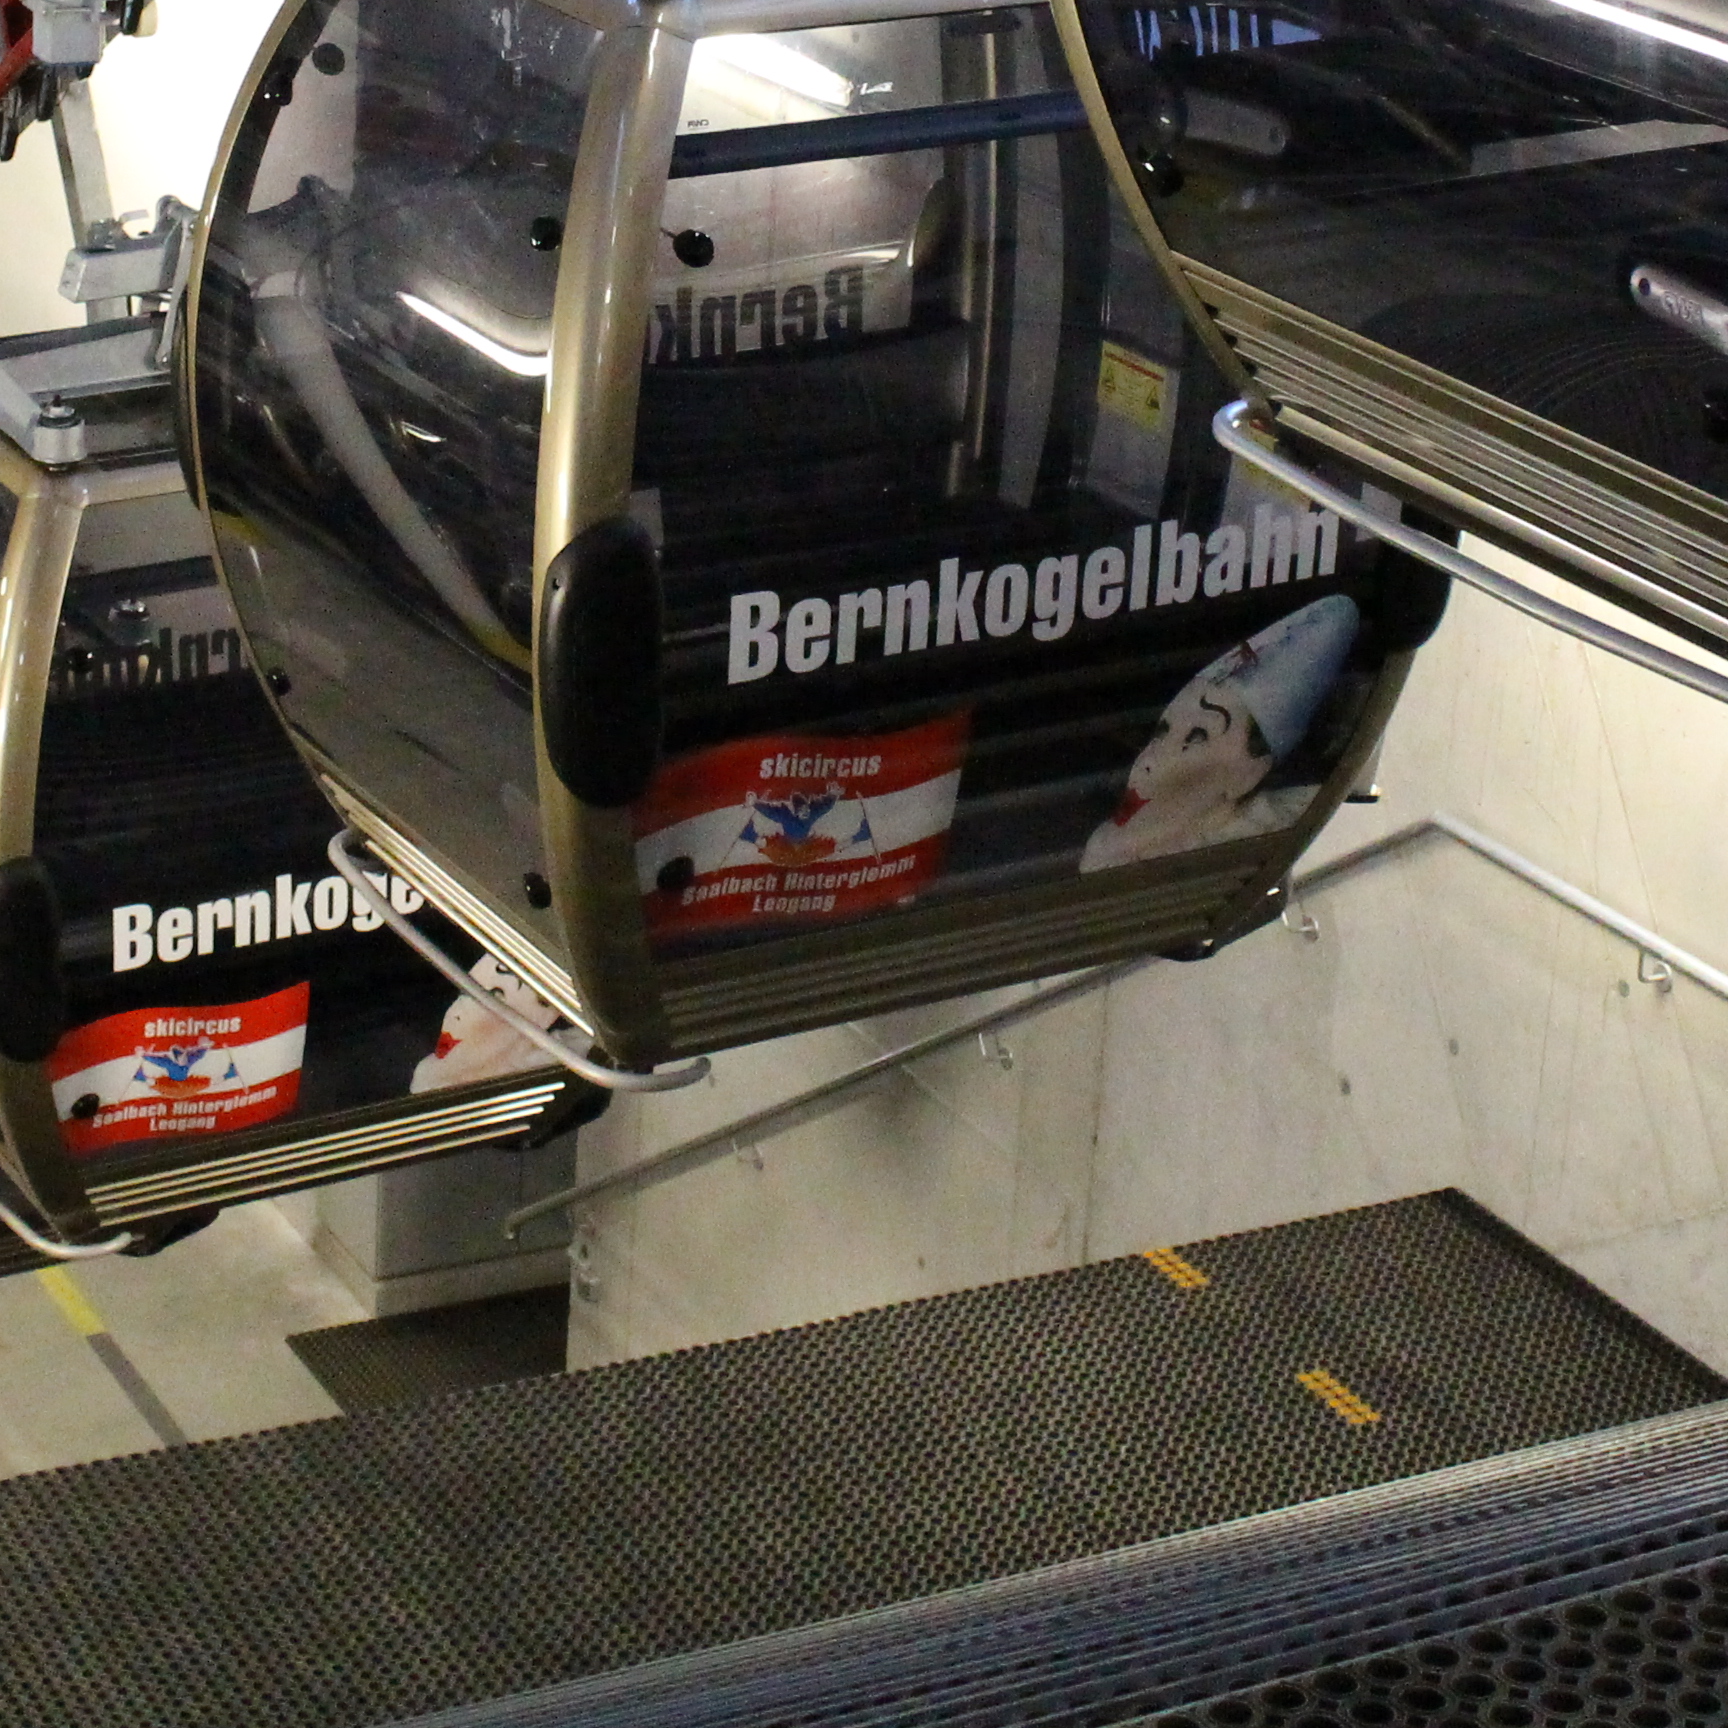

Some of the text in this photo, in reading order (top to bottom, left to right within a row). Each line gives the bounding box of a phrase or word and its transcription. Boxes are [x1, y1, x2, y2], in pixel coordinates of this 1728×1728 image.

[727, 503, 1340, 685] Bernkogelbahn
[759, 753, 882, 779] skicircus
[681, 872, 778, 907] Saalbach
[752, 894, 837, 915] Leogang
[144, 1016, 242, 1038] skicircus
